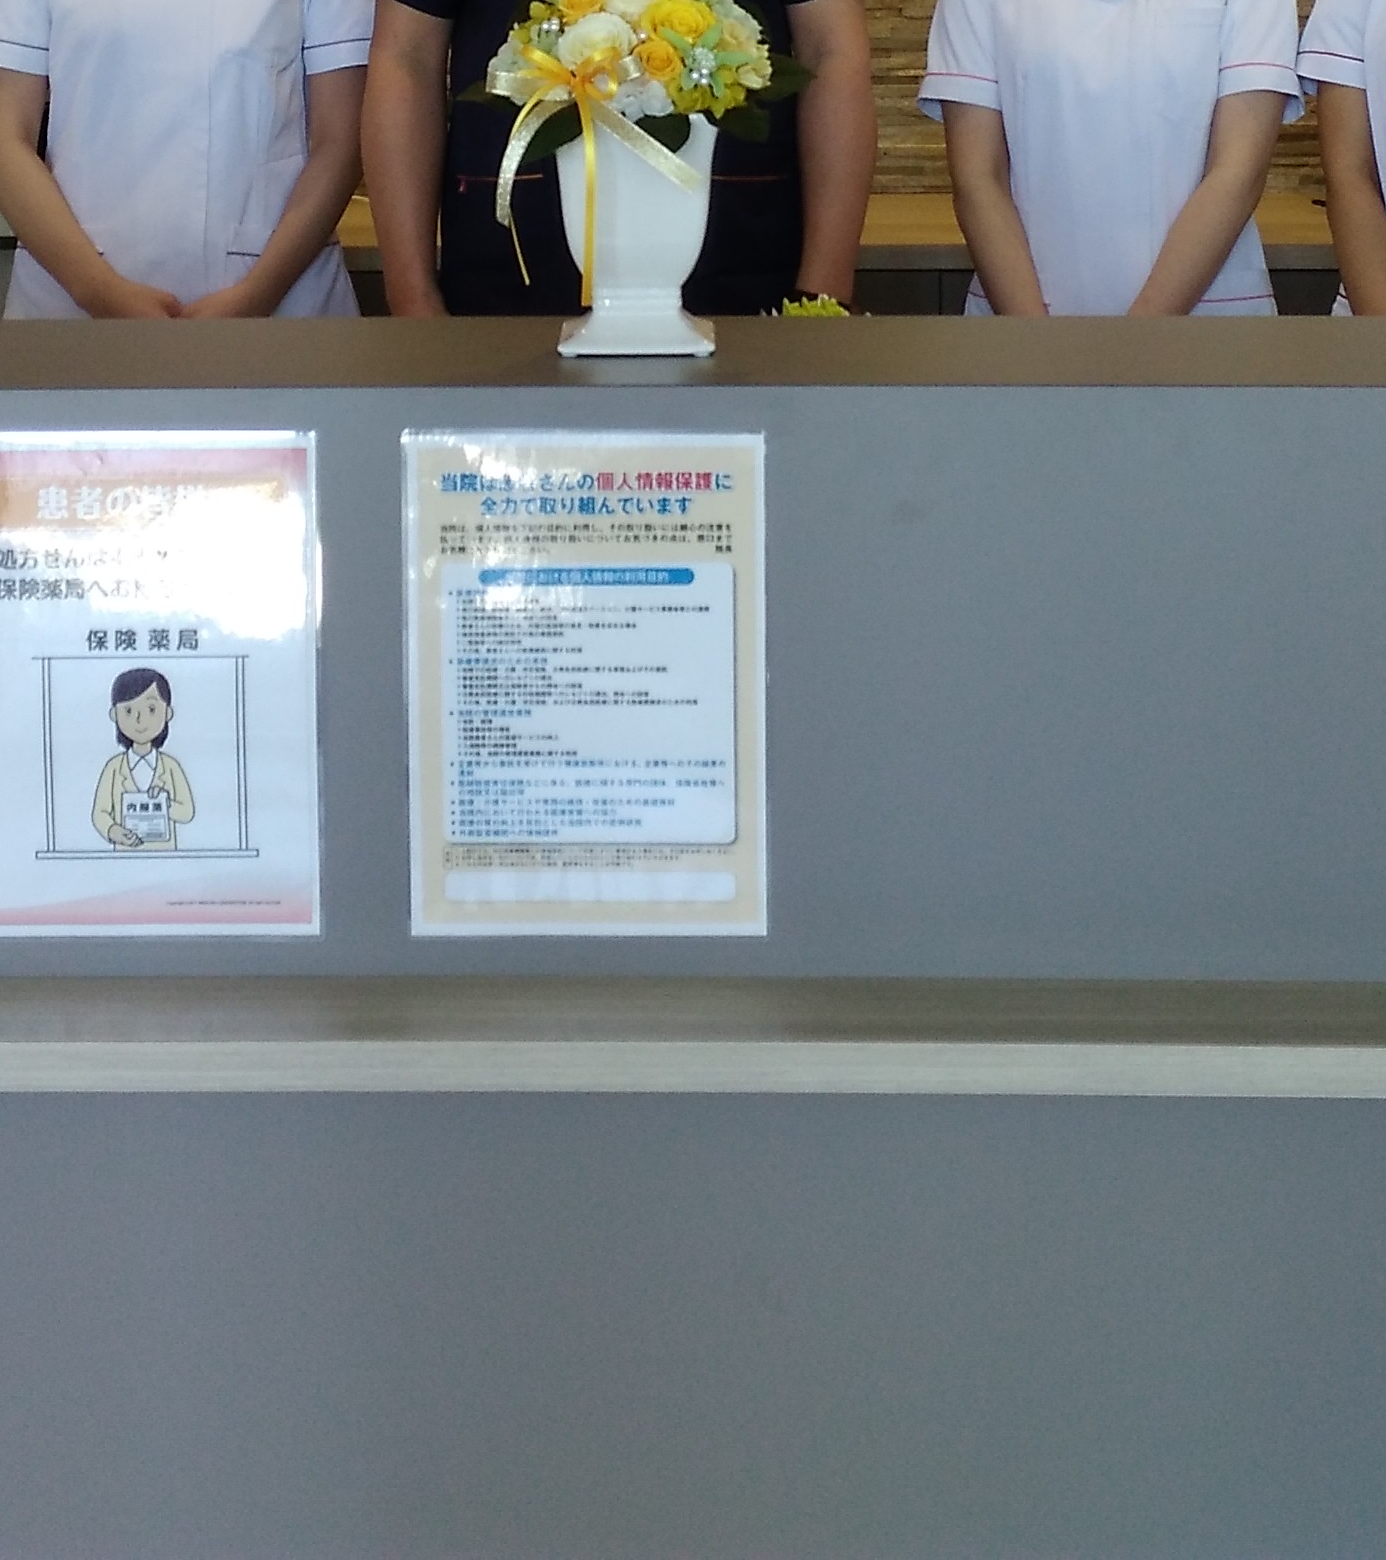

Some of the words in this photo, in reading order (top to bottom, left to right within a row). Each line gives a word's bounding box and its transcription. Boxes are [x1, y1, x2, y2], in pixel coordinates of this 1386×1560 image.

[479, 496, 694, 516] 全力で取り組んでいます
[86, 628, 201, 653] 保険薬局
